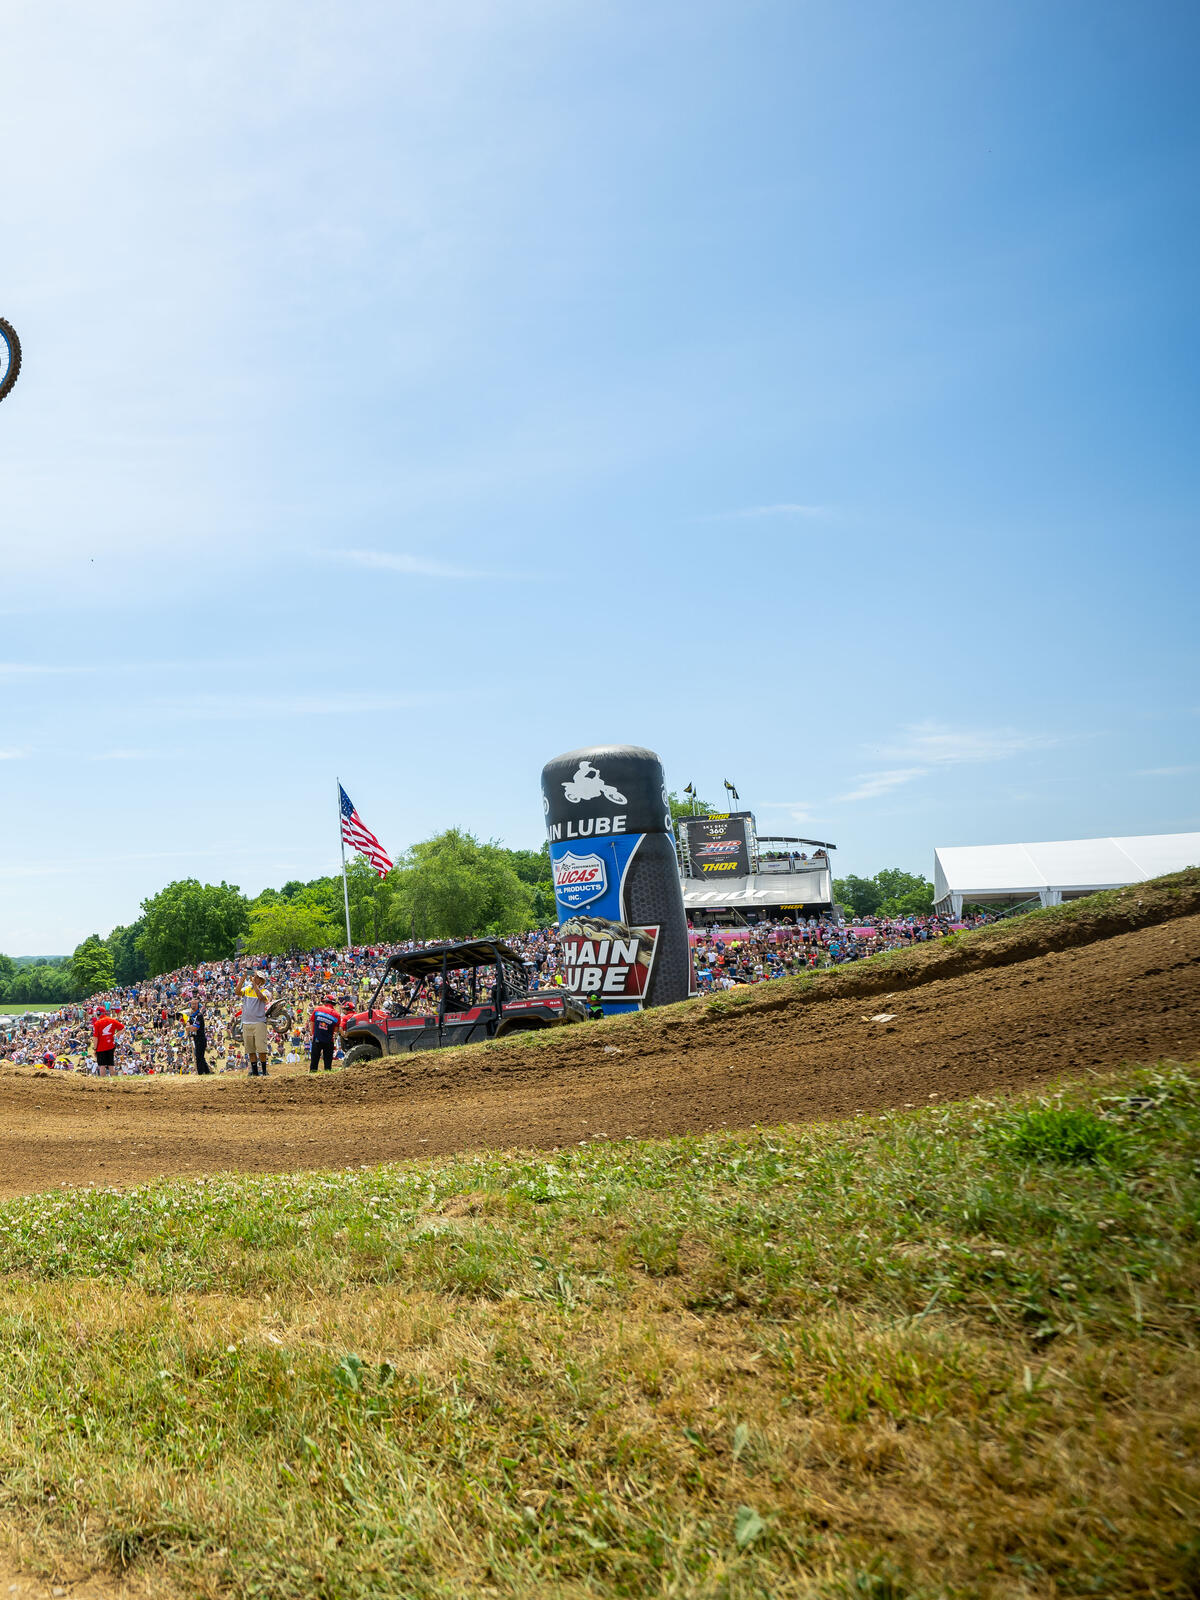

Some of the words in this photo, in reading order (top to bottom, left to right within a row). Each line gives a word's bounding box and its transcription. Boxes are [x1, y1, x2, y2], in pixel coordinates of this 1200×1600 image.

[567, 815, 627, 838] LUBE
[702, 862, 738, 872] THOR
[557, 868, 599, 885] LUCAS
[564, 884, 601, 894] PRODUCTS
[561, 939, 639, 966] HAIN
